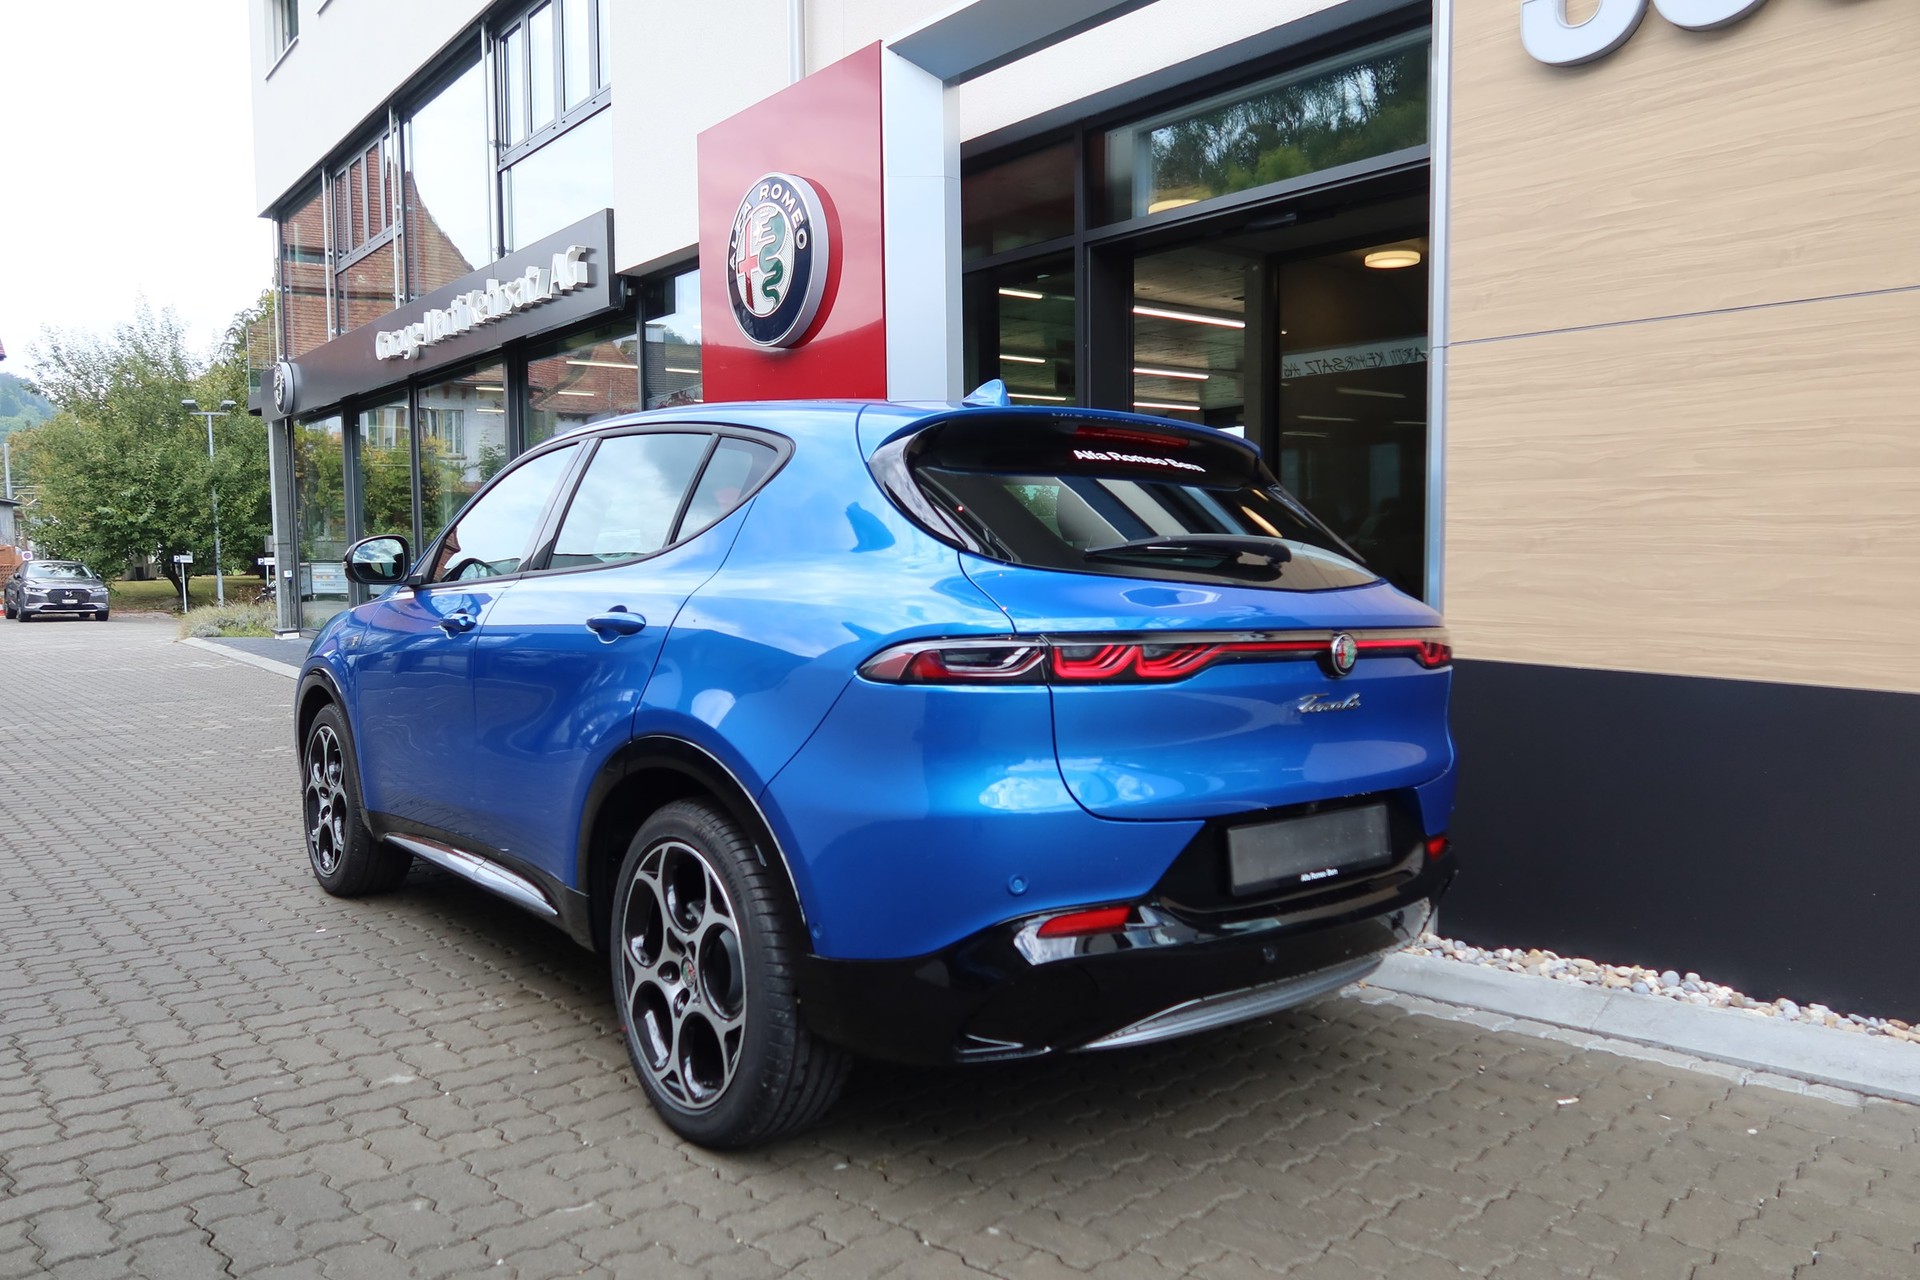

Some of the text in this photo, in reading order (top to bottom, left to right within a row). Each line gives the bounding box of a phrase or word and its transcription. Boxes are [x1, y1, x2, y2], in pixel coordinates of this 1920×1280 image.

[729, 183, 808, 271] ALFA ROMEO
[549, 245, 588, 295] AG
[1073, 450, 1111, 461] Alfa
[1106, 451, 1168, 466] Romeo
